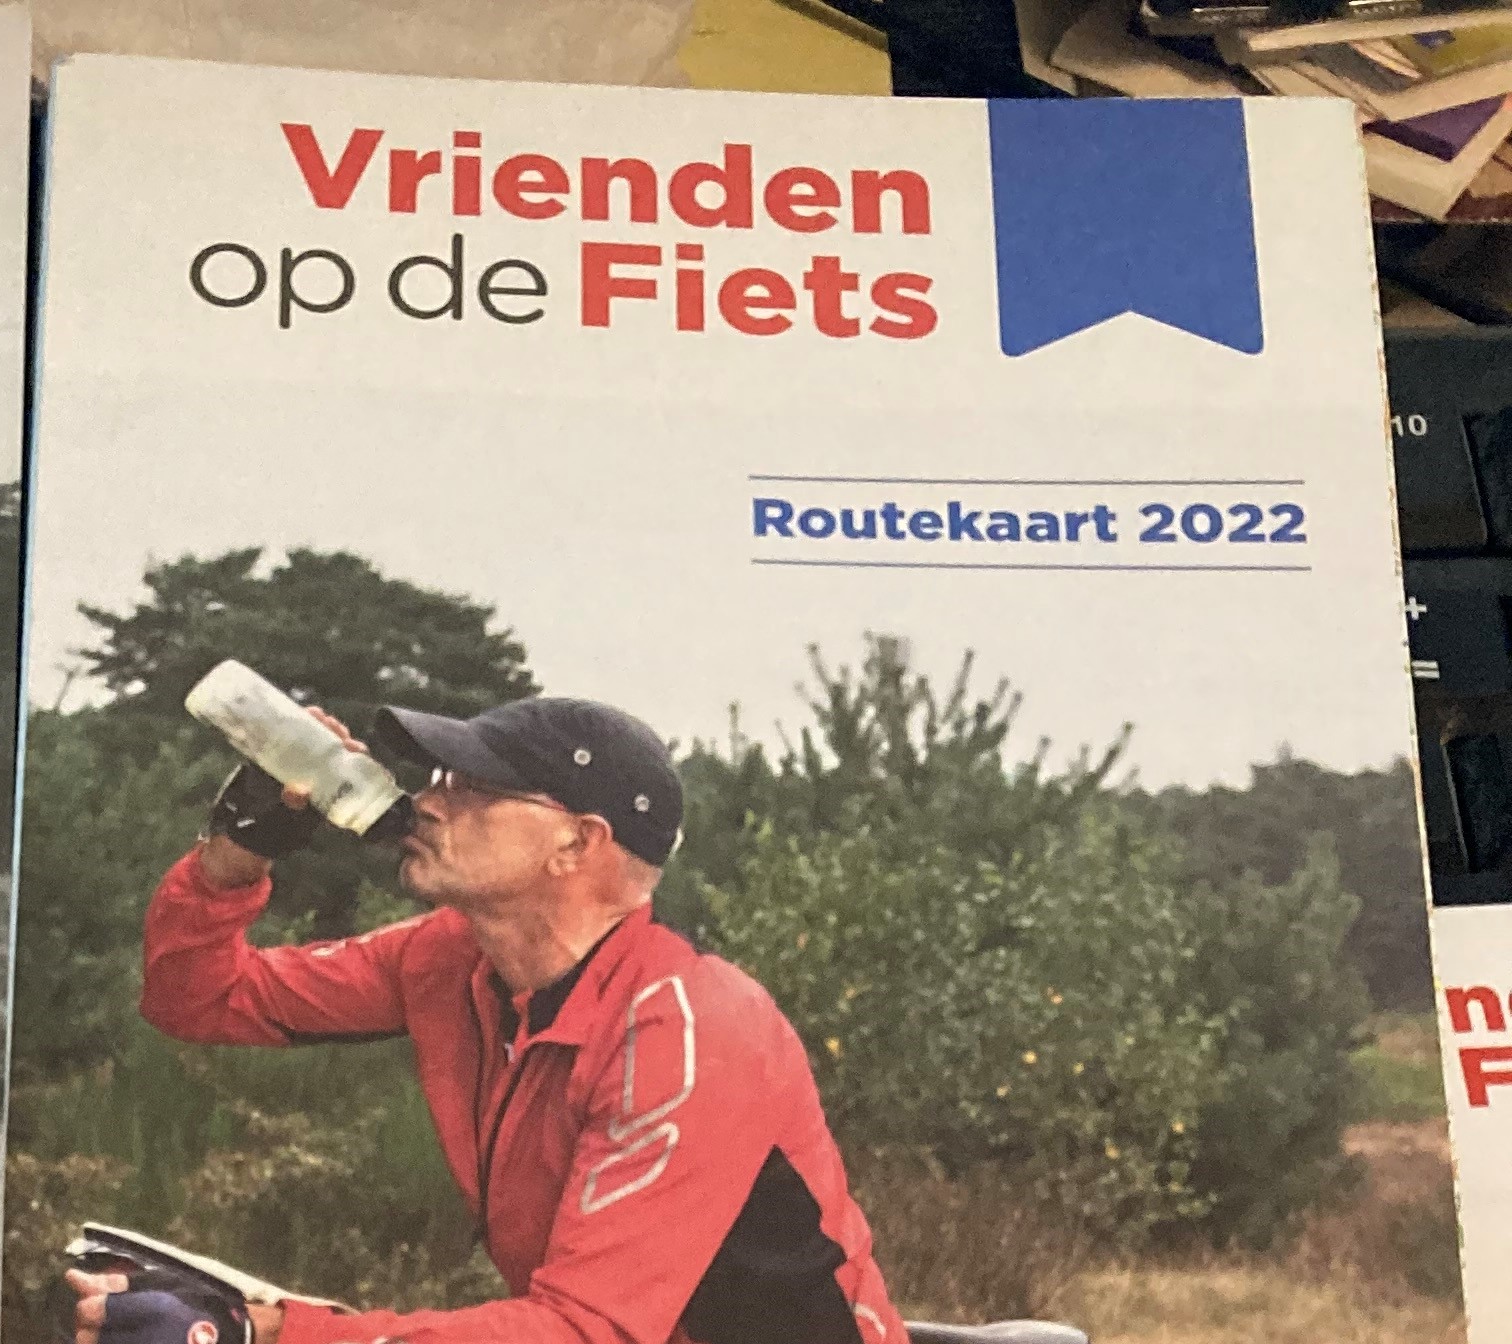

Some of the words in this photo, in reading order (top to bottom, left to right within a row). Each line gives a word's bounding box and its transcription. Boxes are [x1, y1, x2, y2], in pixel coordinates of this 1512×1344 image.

[282, 124, 930, 234] Vrienden
[190, 243, 355, 329] op
[388, 233, 547, 324] de
[581, 242, 937, 339] Fiets
[1391, 414, 1428, 437] 10
[753, 498, 1117, 542] Routekaart
[1139, 504, 1306, 543] 2022
